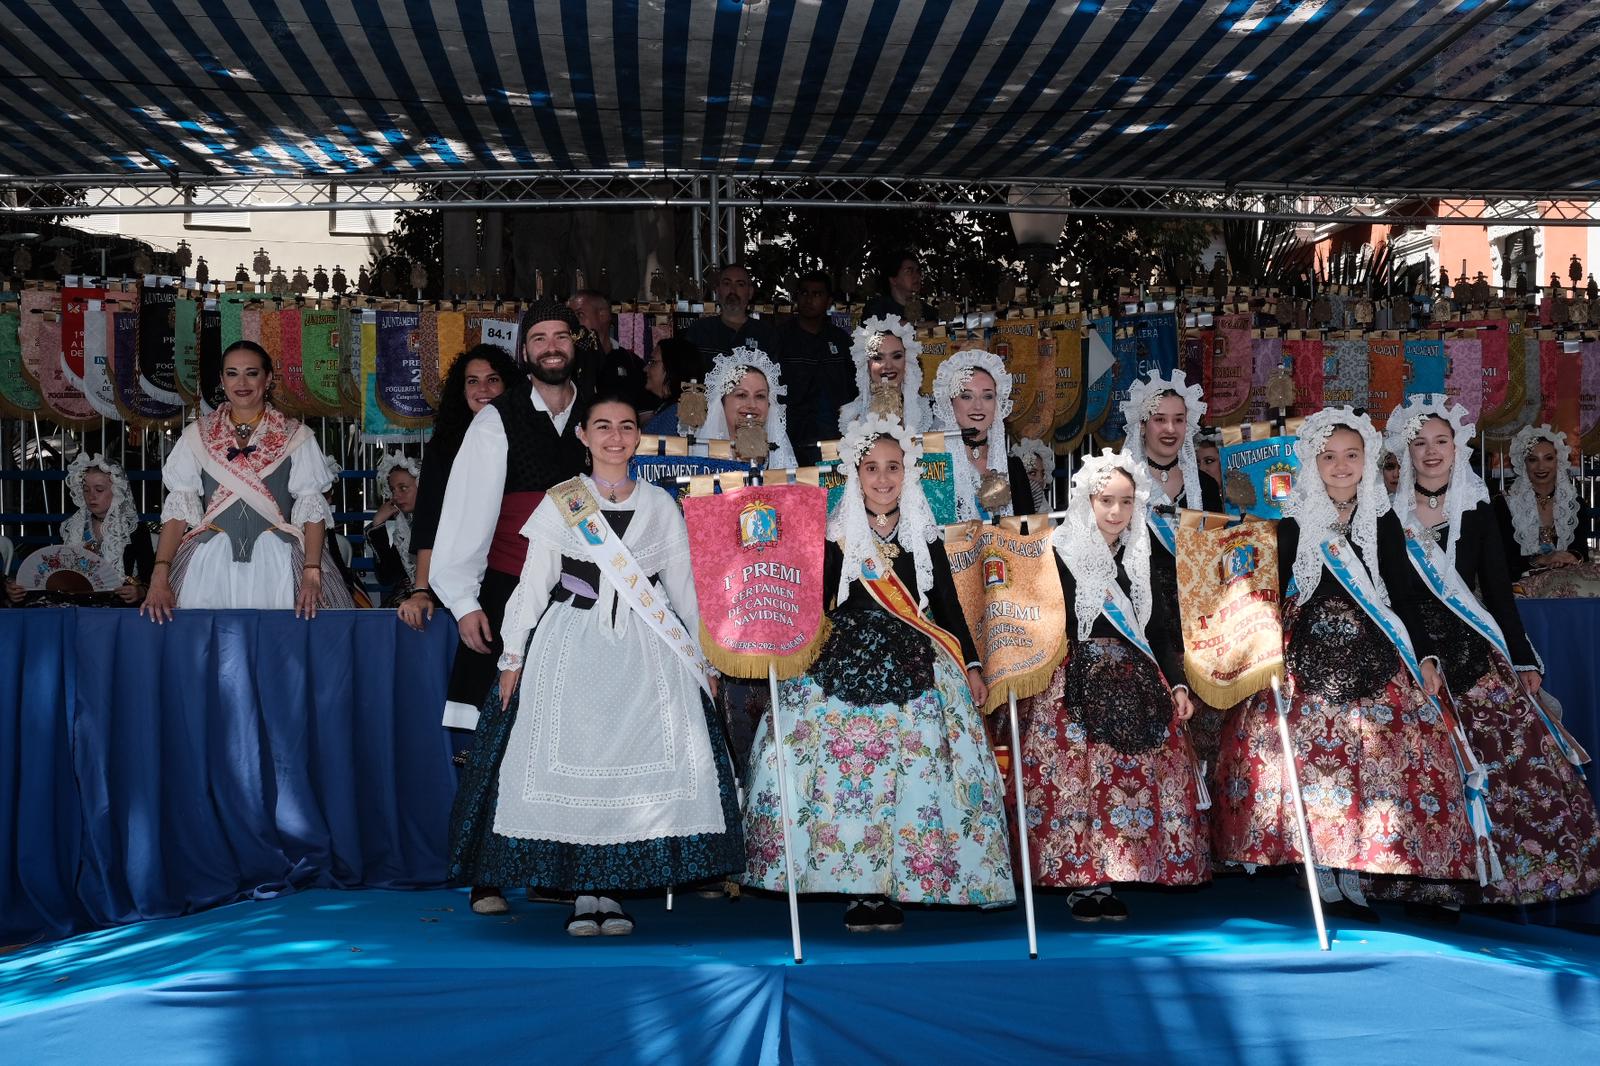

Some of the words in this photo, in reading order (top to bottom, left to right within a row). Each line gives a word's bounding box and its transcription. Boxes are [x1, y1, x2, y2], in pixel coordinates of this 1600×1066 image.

[487, 328, 512, 340] 84.1
[636, 463, 699, 483] AJUNTAMENT
[742, 562, 801, 584] PREMI
[731, 583, 794, 604] CERTAMEN
[728, 605, 743, 619] DE
[745, 596, 800, 614] CANCION
